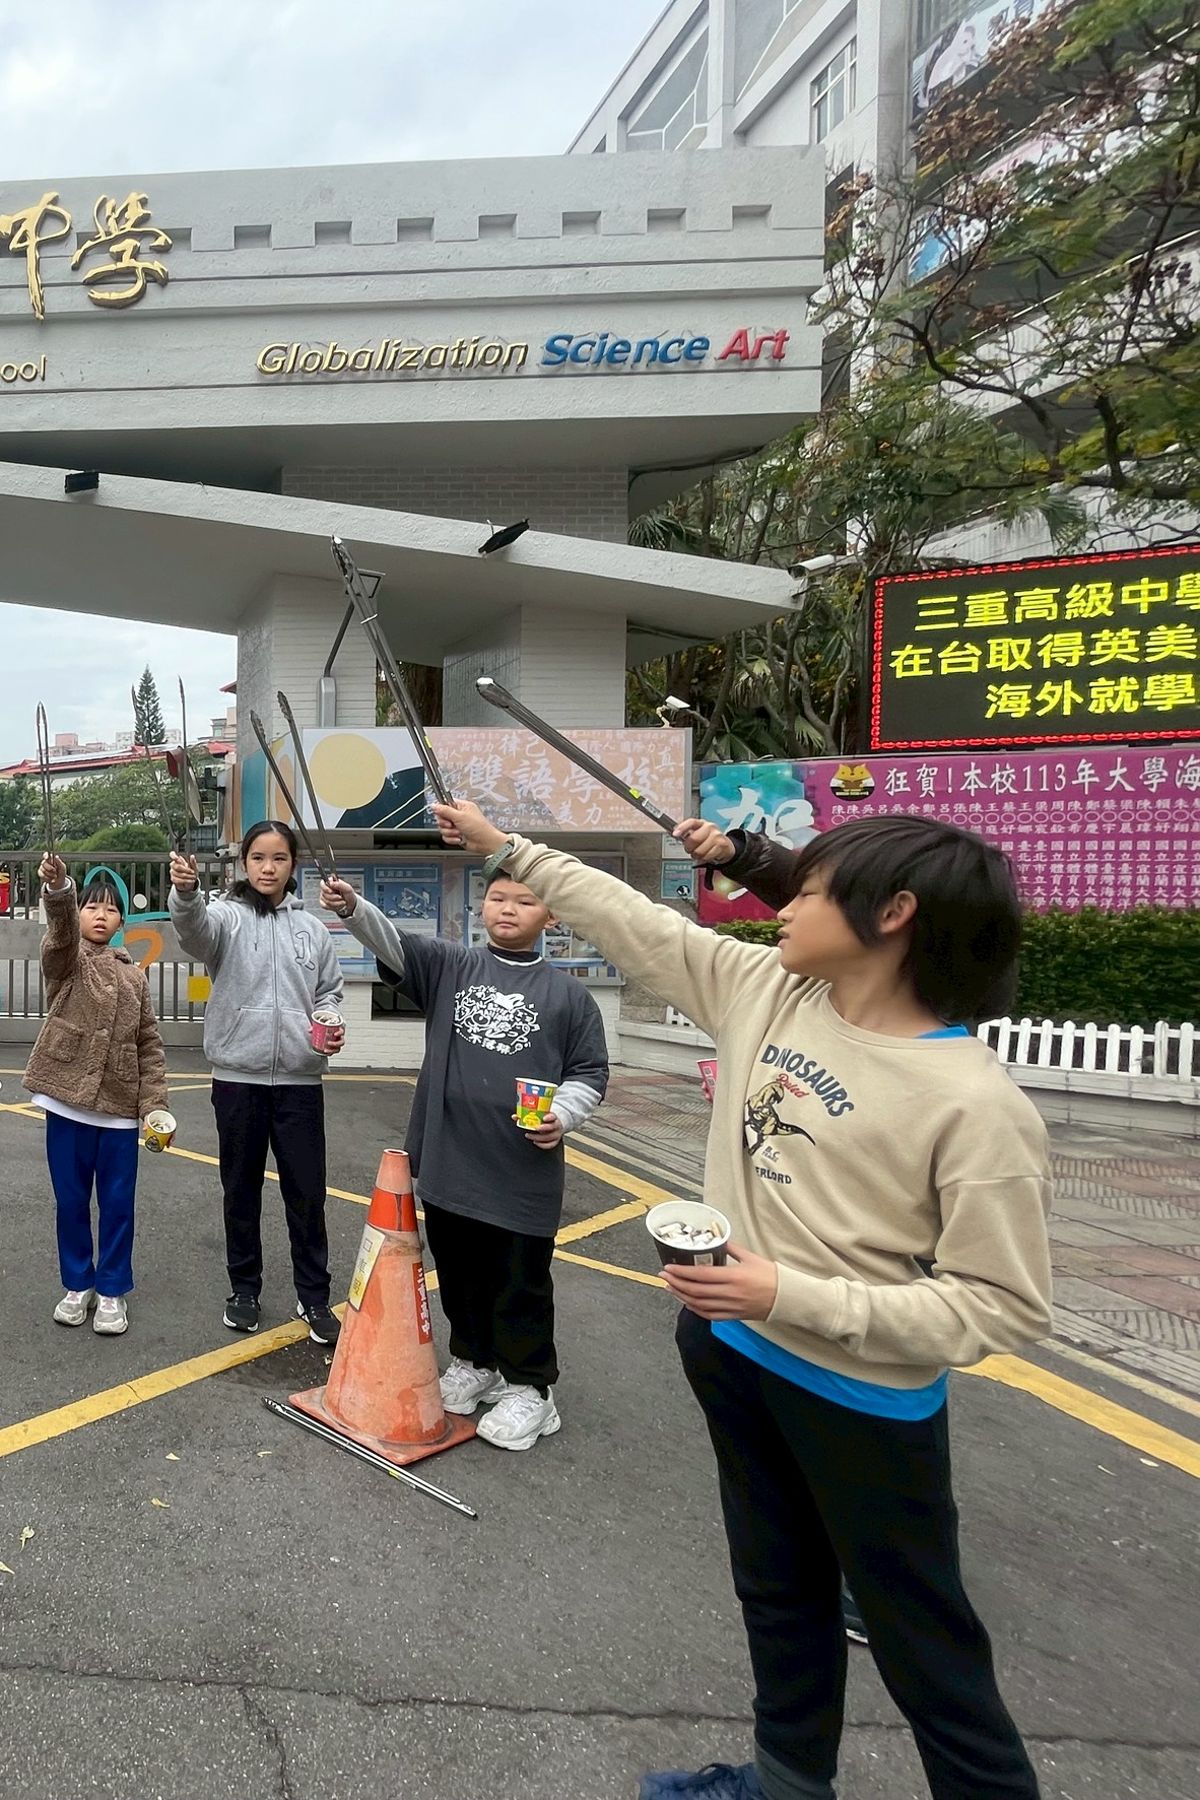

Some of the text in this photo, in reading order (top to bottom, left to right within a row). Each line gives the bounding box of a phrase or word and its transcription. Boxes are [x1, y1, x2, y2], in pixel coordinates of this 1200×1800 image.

[256, 328, 790, 374] Globalization Science Art
[914, 572, 1200, 631] 三重高級中學
[889, 623, 1197, 679] 在台取得英美
[985, 673, 1196, 719] 海外就學
